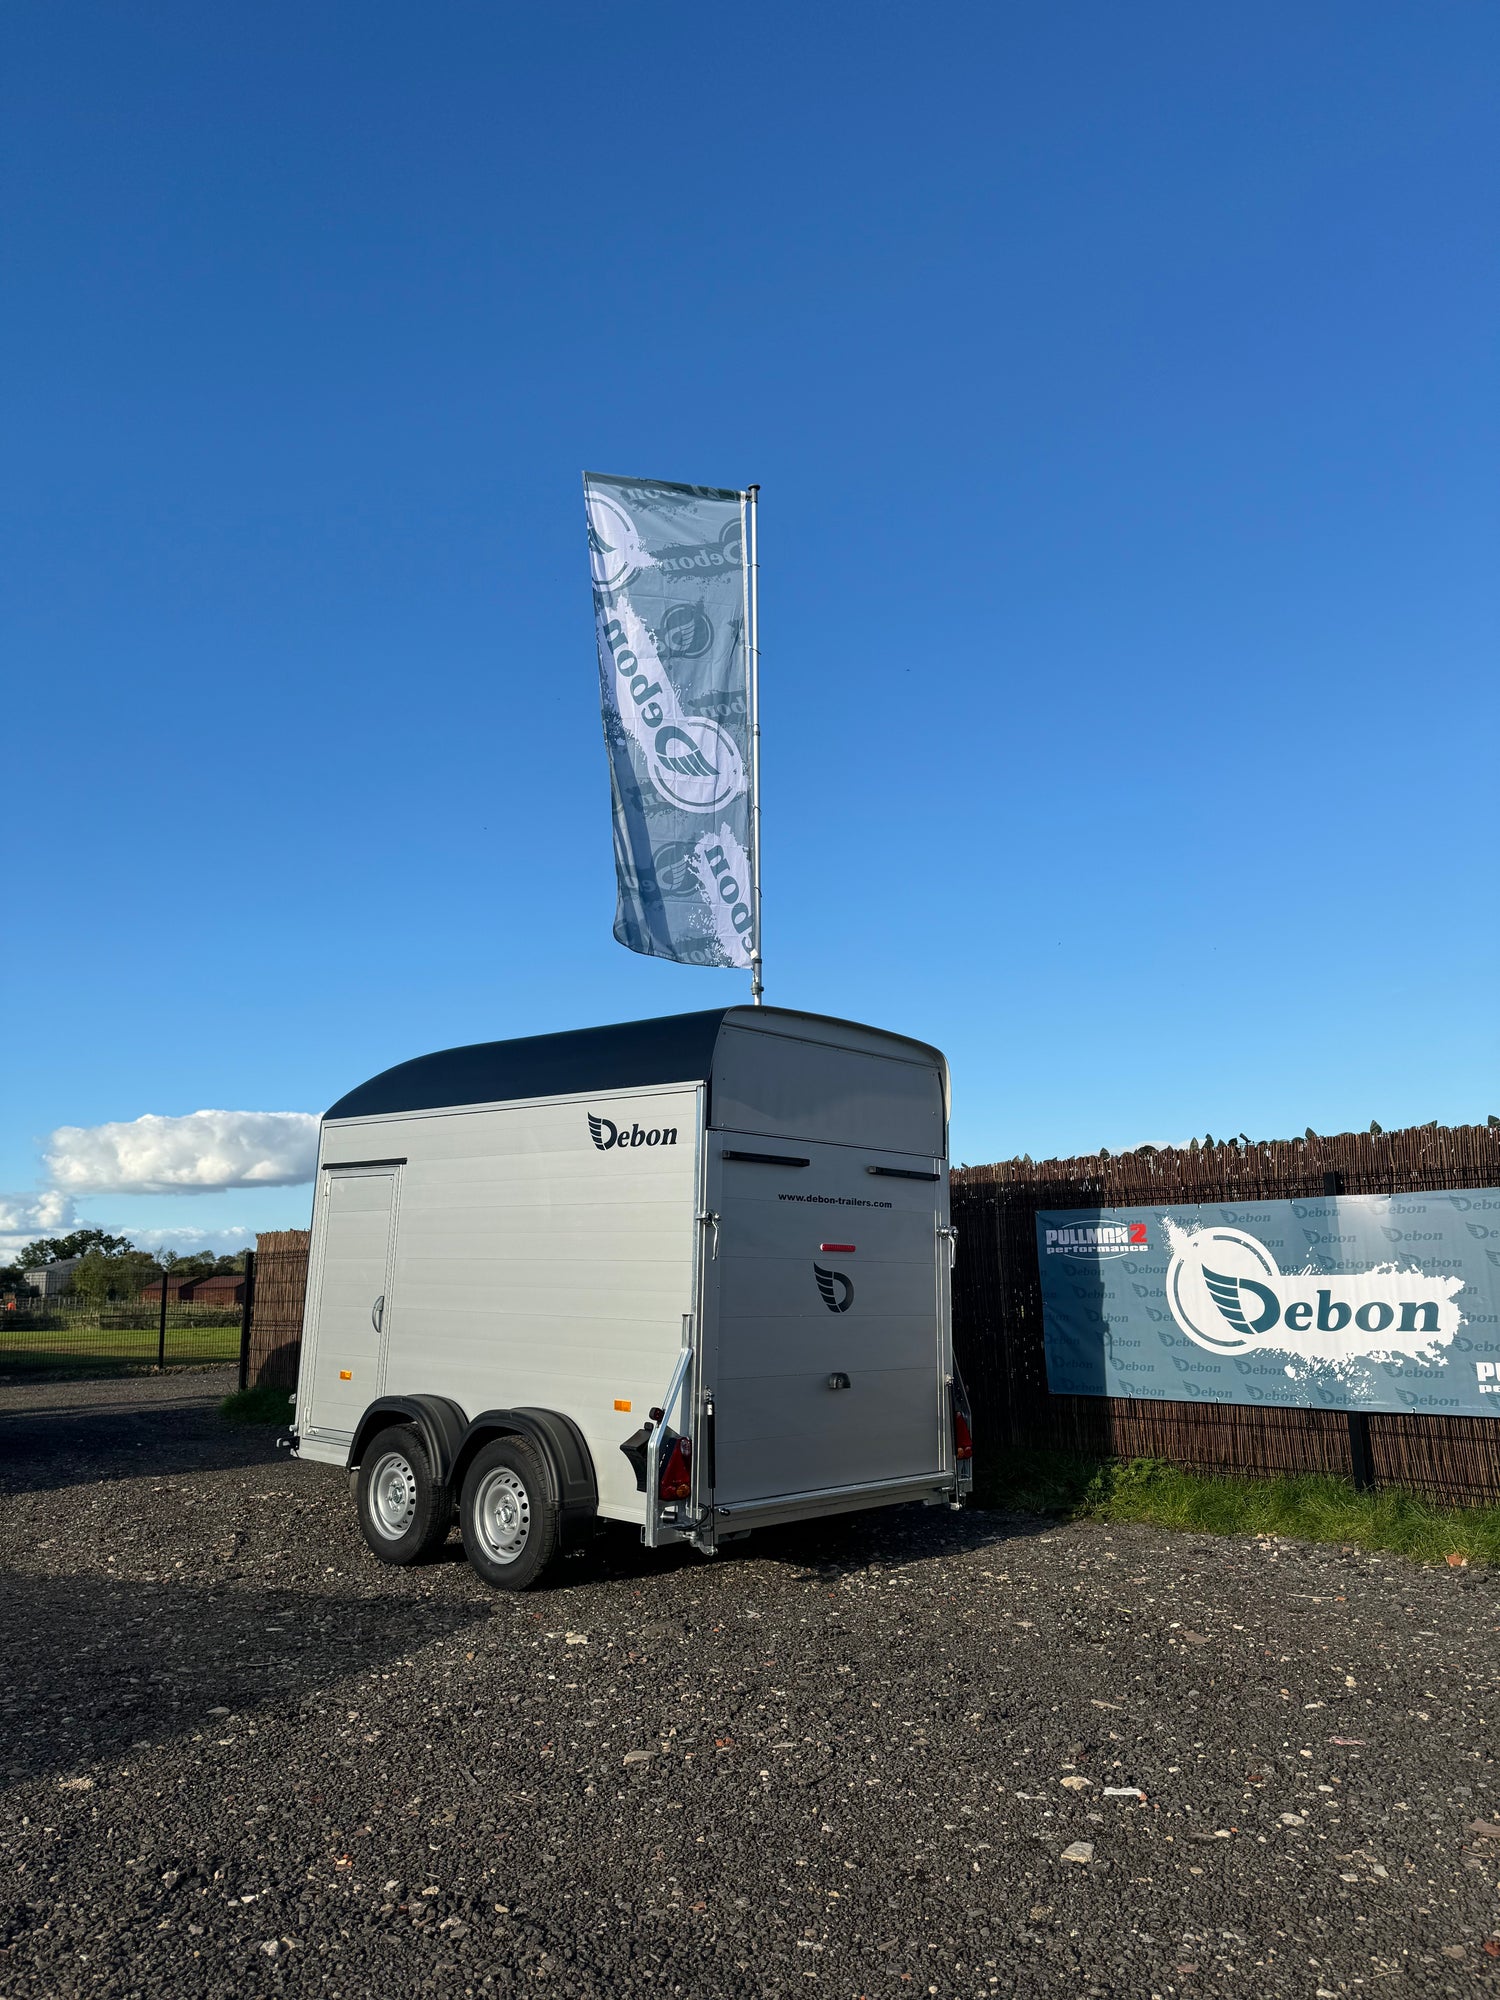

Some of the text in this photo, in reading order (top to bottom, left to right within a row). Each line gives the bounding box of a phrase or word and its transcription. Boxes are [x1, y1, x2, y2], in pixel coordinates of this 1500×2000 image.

[587, 1111, 678, 1151] Debon
[778, 1193, 892, 1209] www.debon-trailers.com
[1448, 1194, 1500, 1212] Debo
[1218, 1208, 1271, 1224] Debon
[1302, 1228, 1357, 1245] Debon
[1380, 1225, 1443, 1243] Debon
[1046, 1245, 1149, 1255] performance
[1316, 1253, 1375, 1271] Debon
[1399, 1250, 1463, 1269] Debon
[1201, 1263, 1441, 1335] Debon
[1110, 1357, 1155, 1372] Debon
[1171, 1355, 1221, 1373] Debon
[1232, 1358, 1286, 1376] Debon
[1381, 1362, 1445, 1379] Debon
[1118, 1378, 1165, 1397] Debon
[1183, 1379, 1233, 1399] Debon
[1394, 1386, 1460, 1407] Debon
